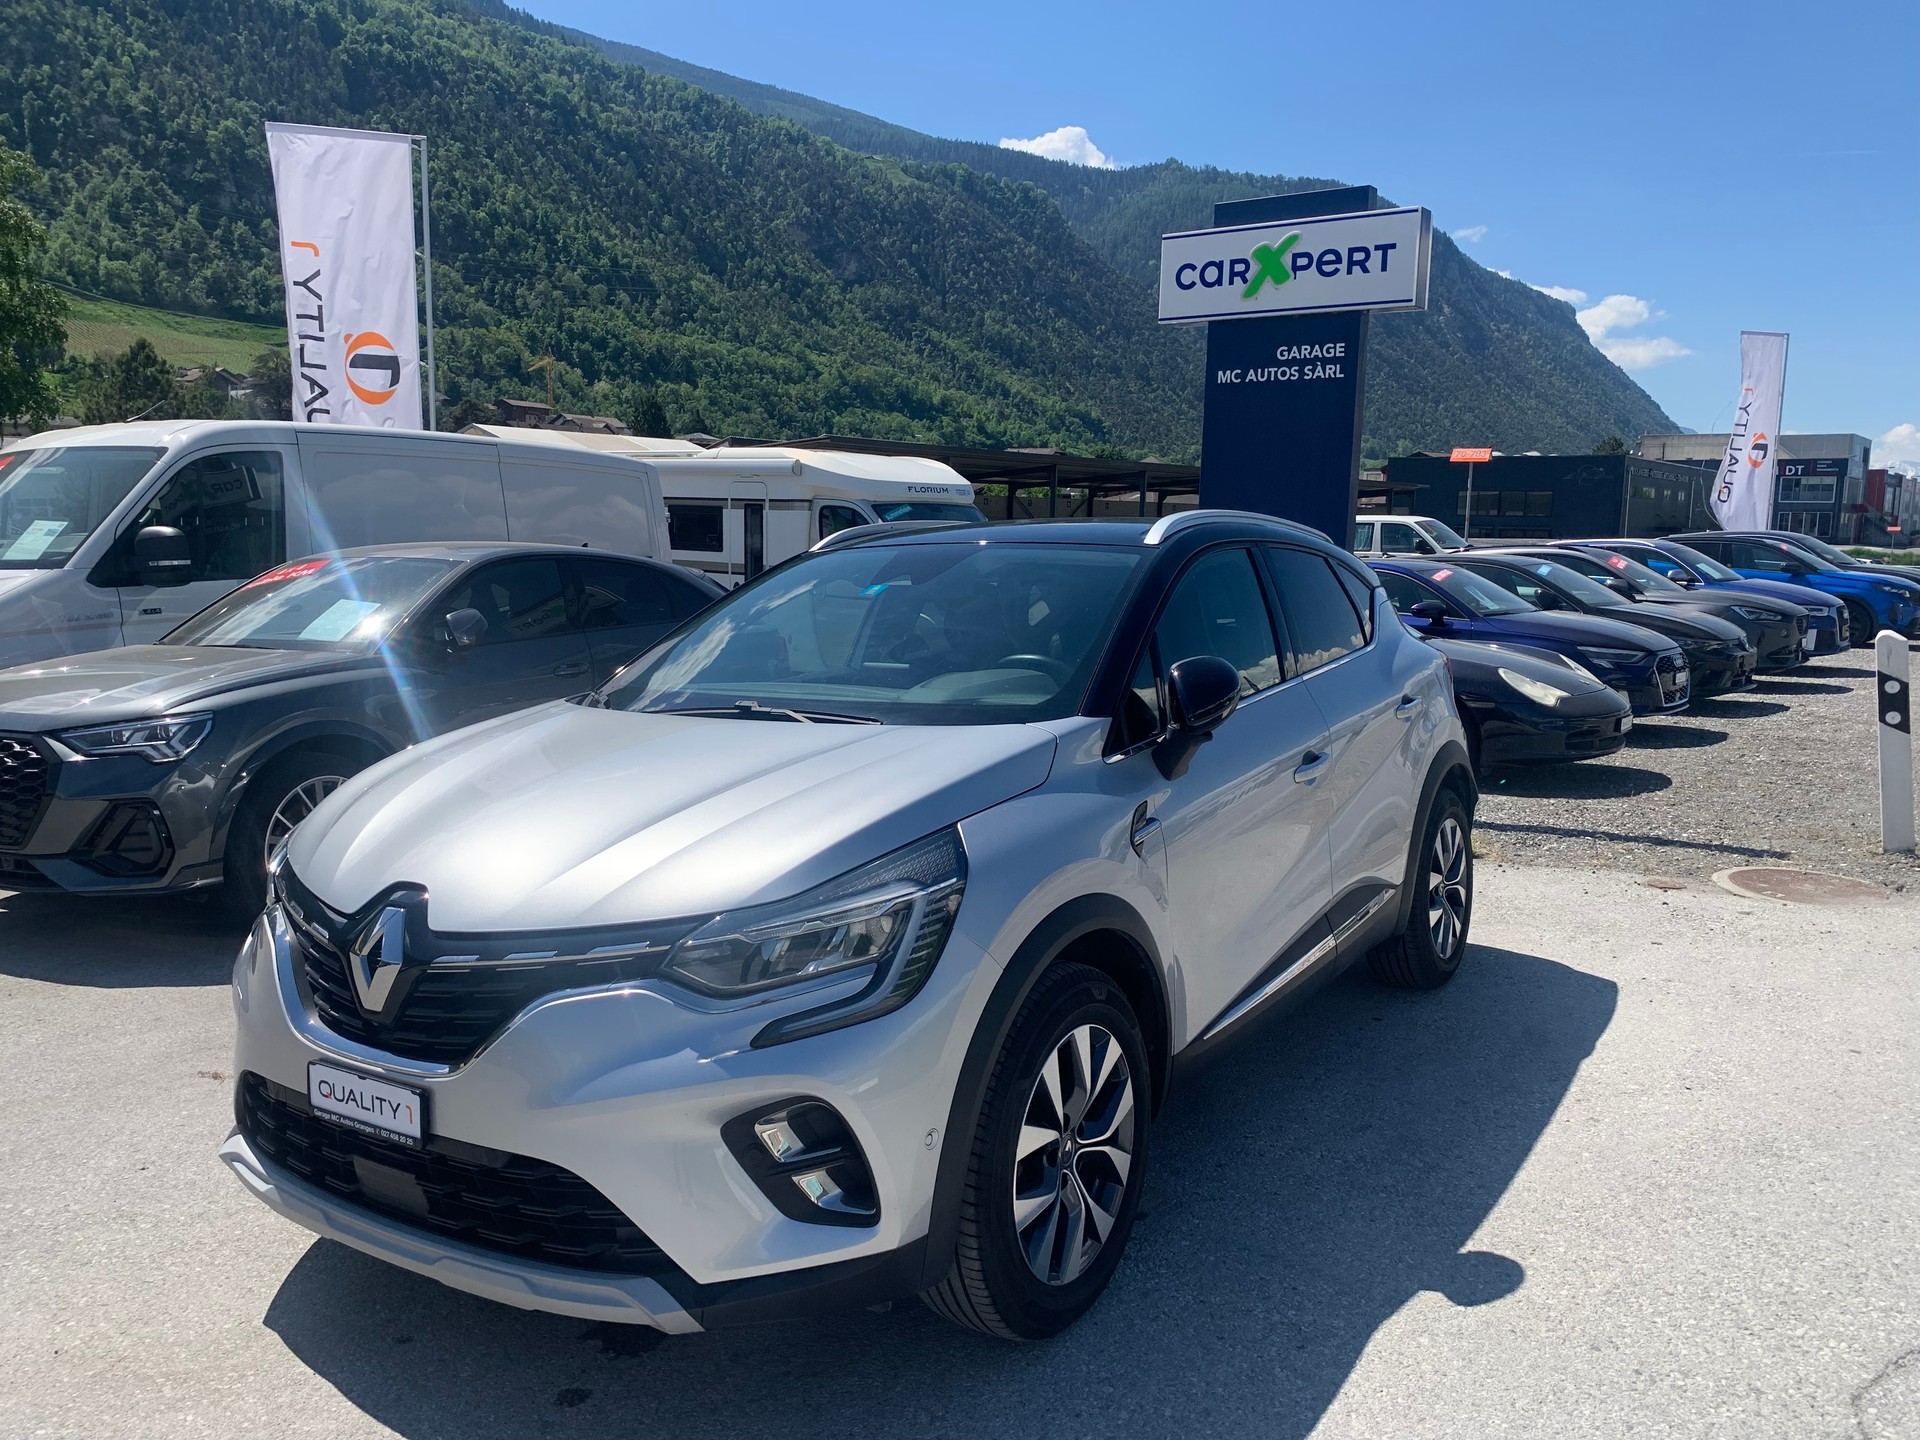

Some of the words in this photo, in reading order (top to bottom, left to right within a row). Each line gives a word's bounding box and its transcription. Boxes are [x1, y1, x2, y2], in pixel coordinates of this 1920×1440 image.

[1276, 343, 1345, 361] GARAGE
[1217, 369, 1242, 384] MC
[1245, 366, 1299, 383] AUTOS
[1303, 361, 1345, 380] SÀRL
[907, 486, 949, 494] FLORIUM
[318, 1080, 401, 1120] QUALITY
[313, 1108, 331, 1120] Garage
[330, 1114, 340, 1122] MC
[340, 1116, 354, 1127] Autos
[354, 1121, 375, 1133] Granges
